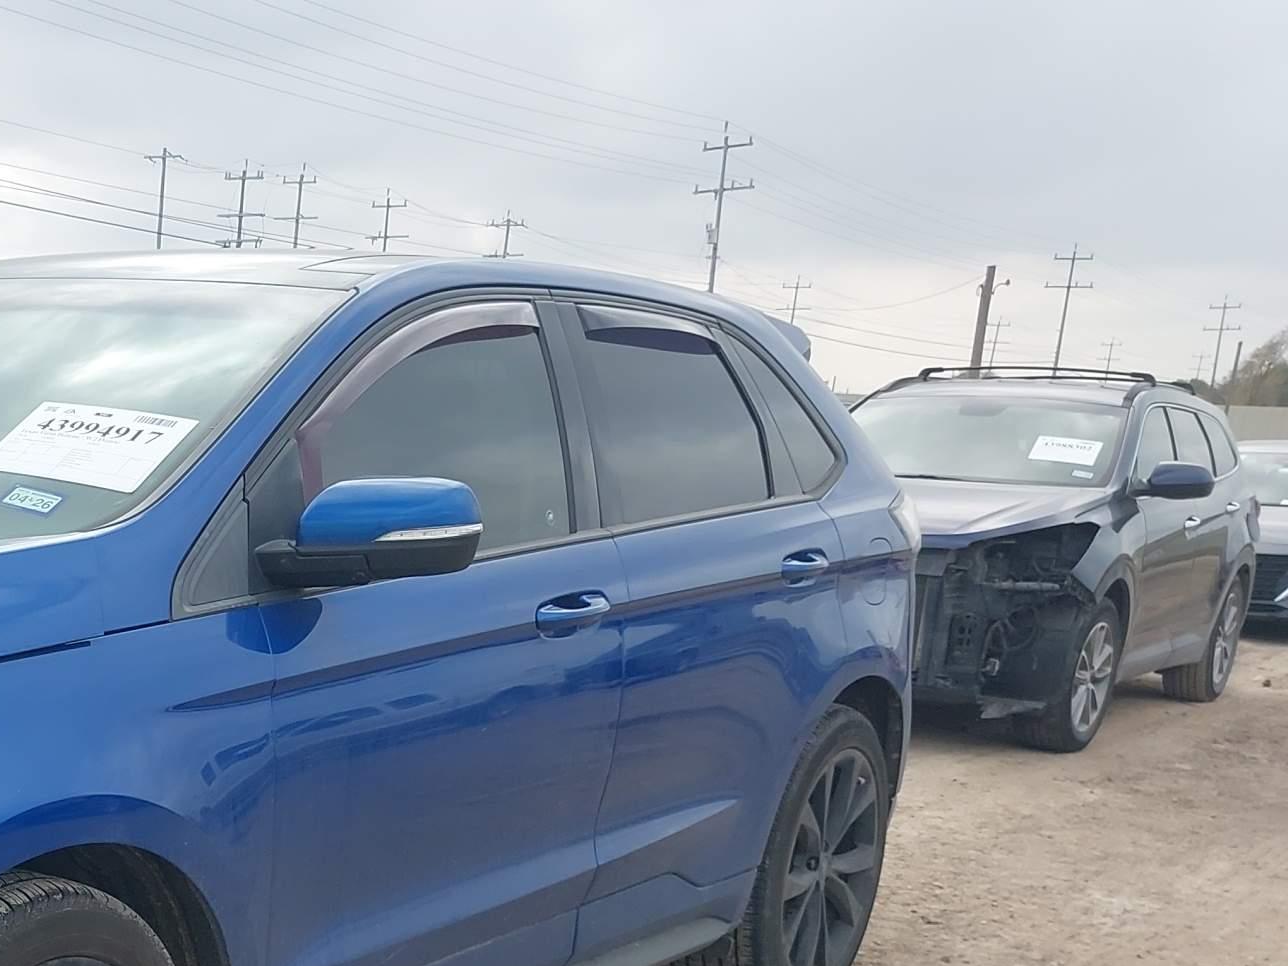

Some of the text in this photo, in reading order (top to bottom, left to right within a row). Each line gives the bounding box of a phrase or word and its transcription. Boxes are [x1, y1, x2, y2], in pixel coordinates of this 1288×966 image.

[36, 417, 164, 445] 43994917
[8, 492, 54, 510] 04 26
